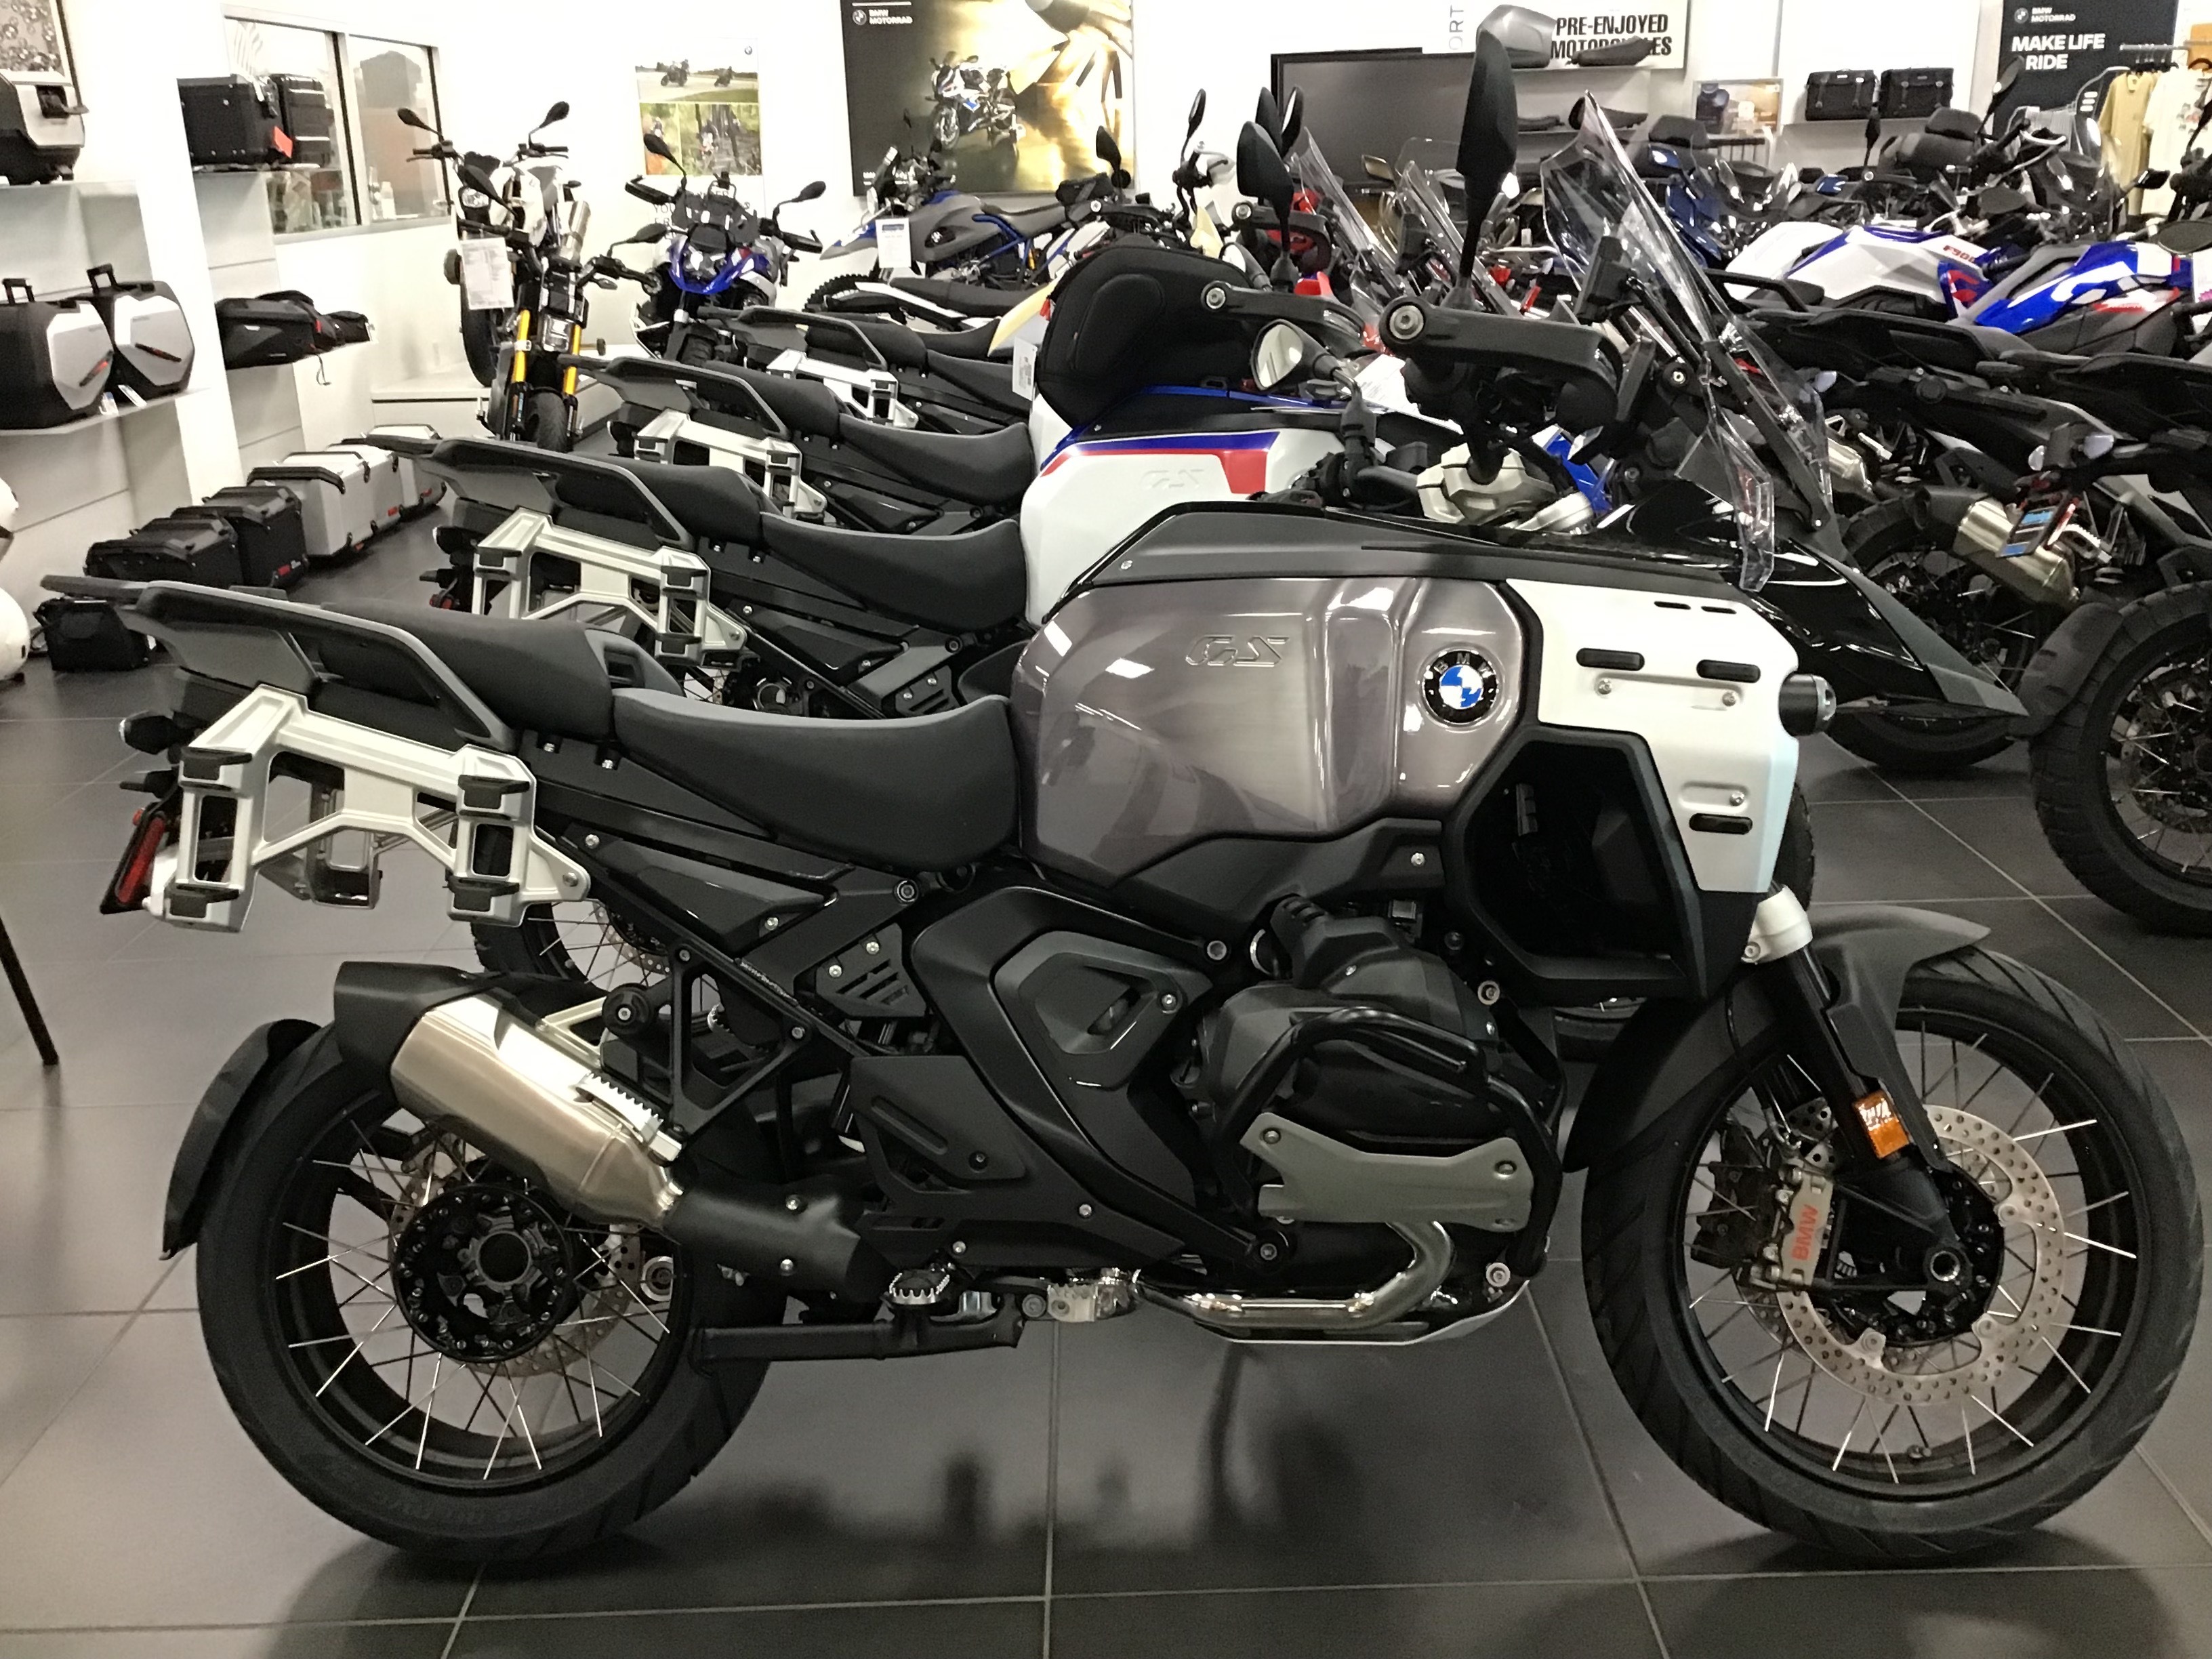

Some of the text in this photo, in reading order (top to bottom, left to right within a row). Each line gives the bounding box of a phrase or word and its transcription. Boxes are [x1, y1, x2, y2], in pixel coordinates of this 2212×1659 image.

[869, 16, 913, 24] MOTORRAD
[1557, 14, 1668, 36] PRE-ENJOYED
[2031, 14, 2076, 23] MOTORRAD
[2012, 33, 2106, 52] MAKE LIFE
[2026, 54, 2069, 70] RIDE
[1186, 634, 1290, 668] GS
[1433, 653, 1494, 678] BMW
[1791, 1204, 1819, 1261] BMW
